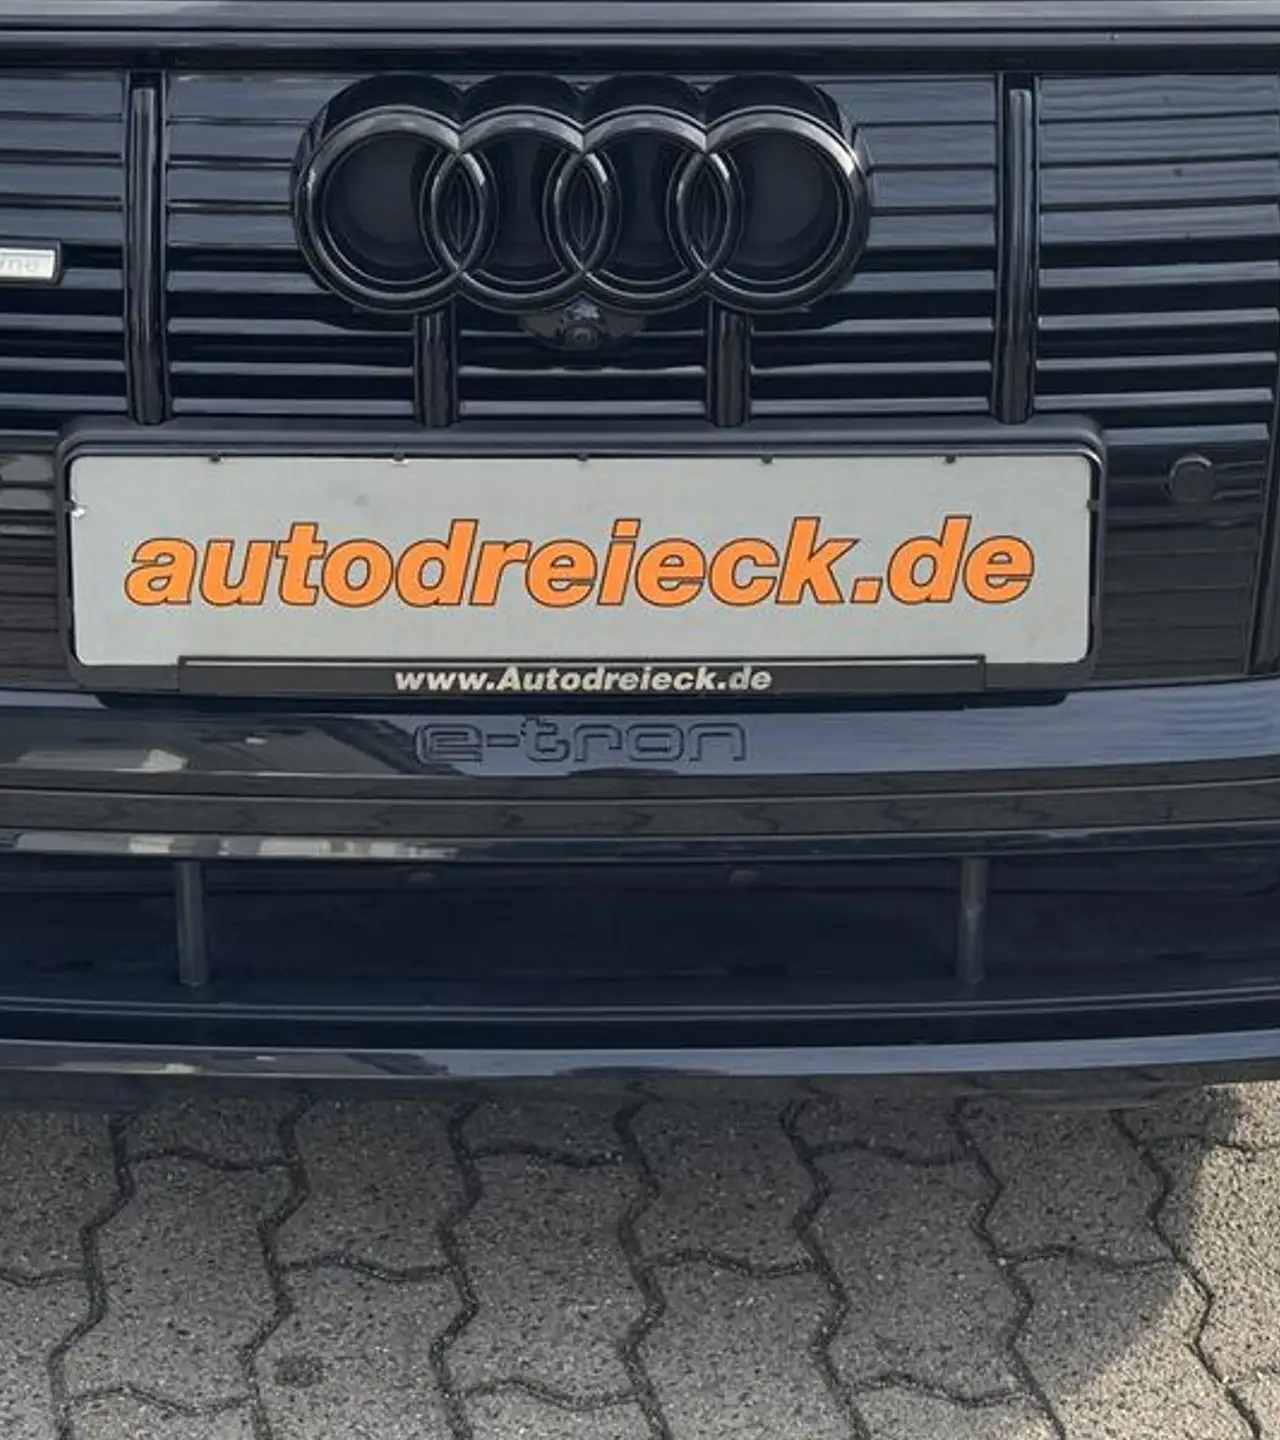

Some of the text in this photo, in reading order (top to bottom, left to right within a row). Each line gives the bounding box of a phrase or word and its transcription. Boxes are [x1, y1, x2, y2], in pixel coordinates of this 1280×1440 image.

[123, 514, 1037, 609] autodreieck.de
[393, 663, 773, 693] www.Autodreieck.de
[413, 715, 750, 765] e-tron
